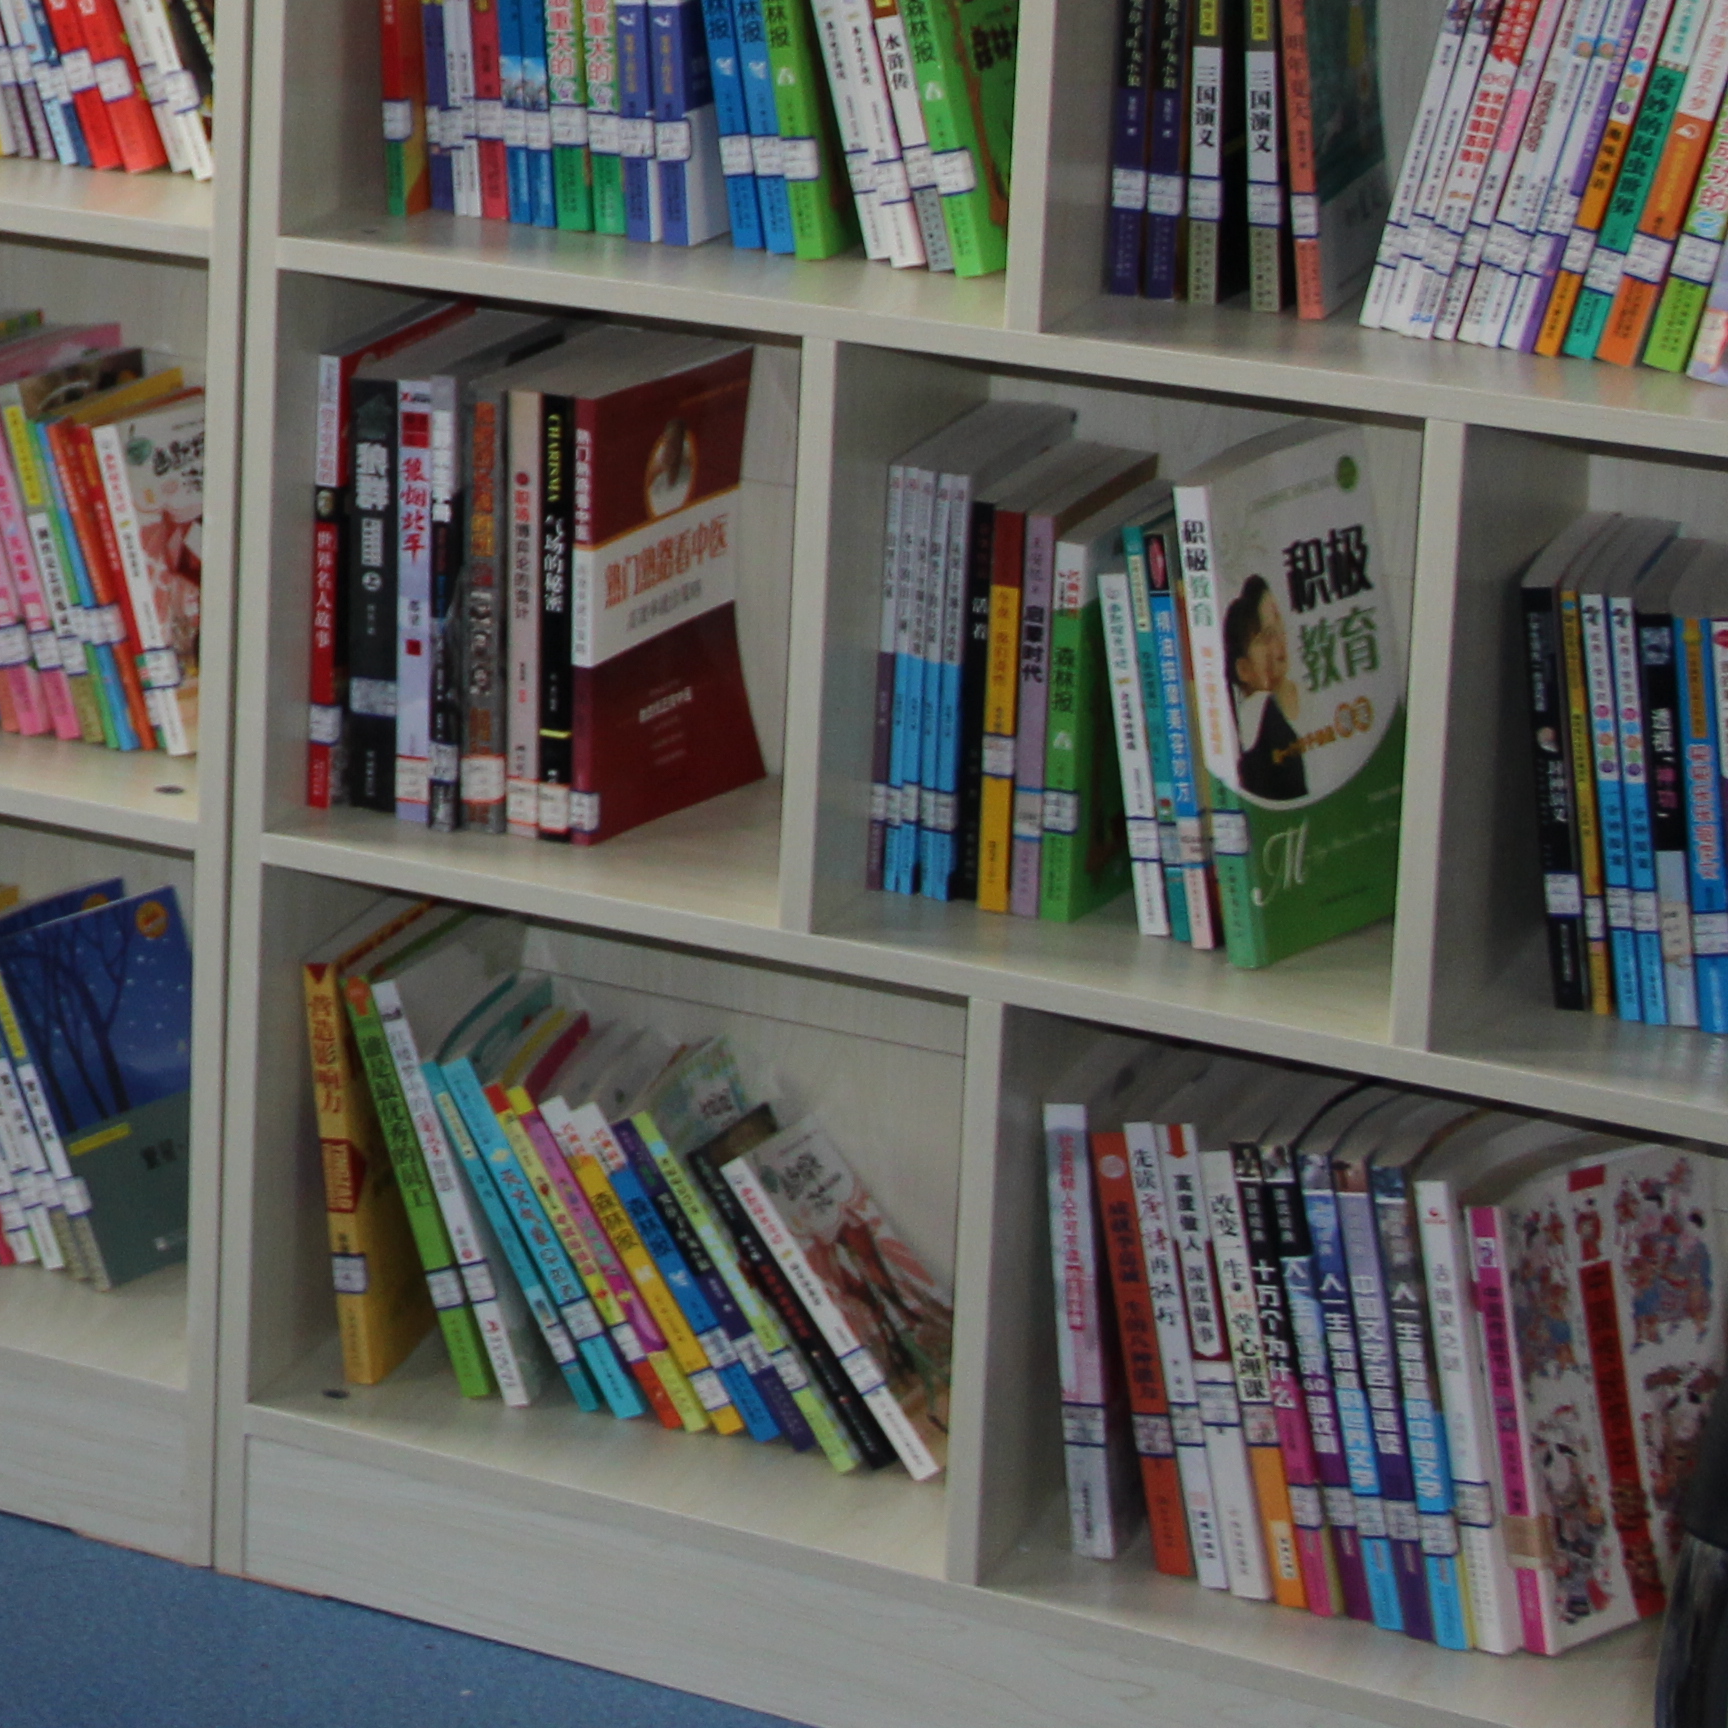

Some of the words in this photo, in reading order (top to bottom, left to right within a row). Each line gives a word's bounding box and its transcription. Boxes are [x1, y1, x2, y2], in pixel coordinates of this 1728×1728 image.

[882, 34, 909, 90] 水浒传
[1196, 64, 1217, 149] 三国演义
[1250, 69, 1271, 153] 三国演义
[547, 413, 563, 503] CHARISMA
[401, 456, 429, 564] 狼烟北平
[316, 531, 335, 648] 世界名人故事
[1182, 519, 1212, 628] 积极教育
[1282, 523, 1374, 614] 积极
[1298, 606, 1381, 693] 教育
[1251, 1257, 1297, 1409] 十万个为什么
